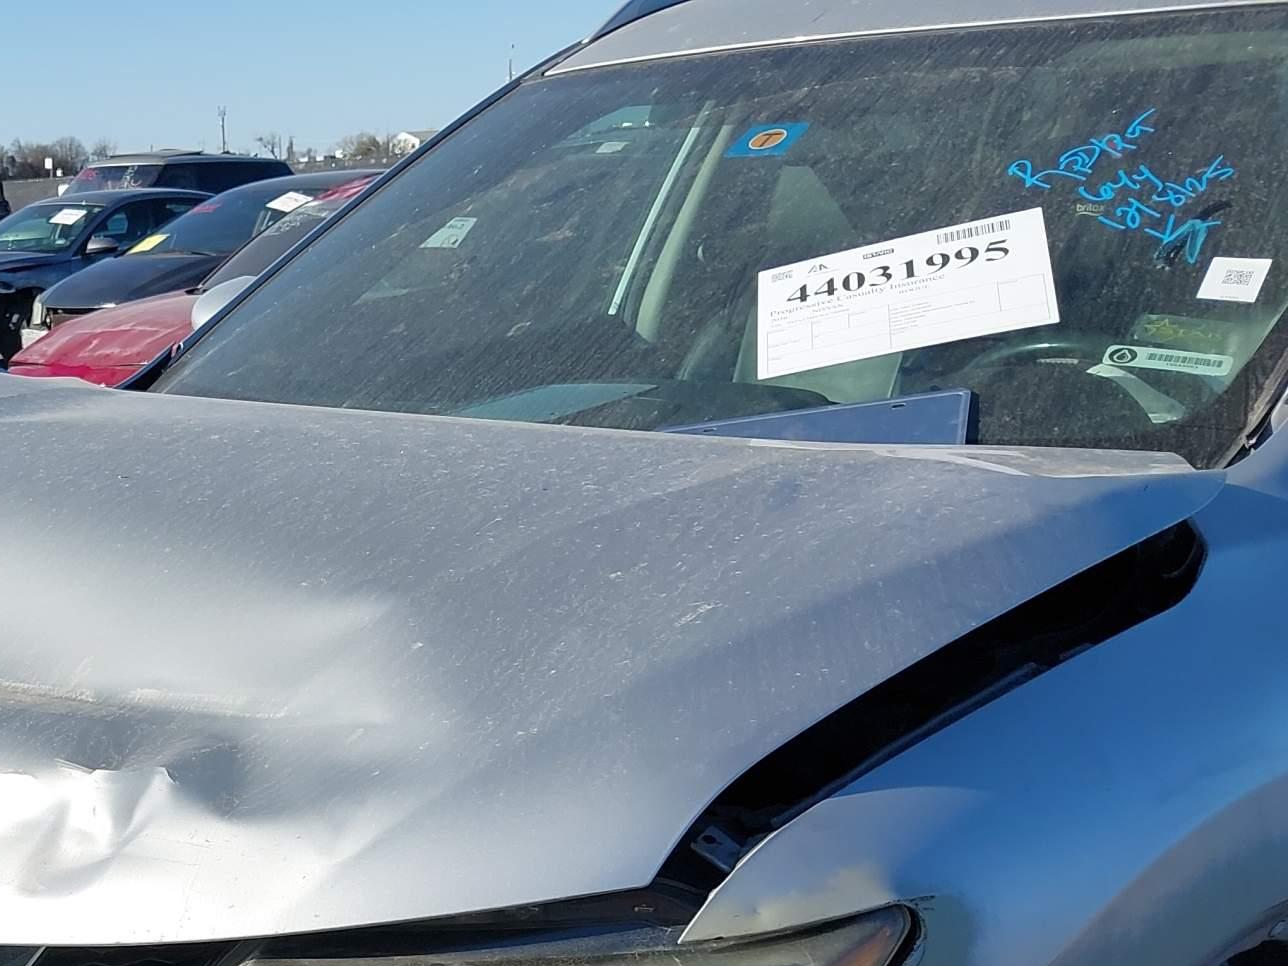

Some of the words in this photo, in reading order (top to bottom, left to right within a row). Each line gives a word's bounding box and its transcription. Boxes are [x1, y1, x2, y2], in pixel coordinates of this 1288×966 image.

[770, 299, 834, 318] Progressive
[836, 286, 887, 302] Casualty
[890, 274, 945, 290] Insurance
[786, 238, 1010, 303] 44031995
